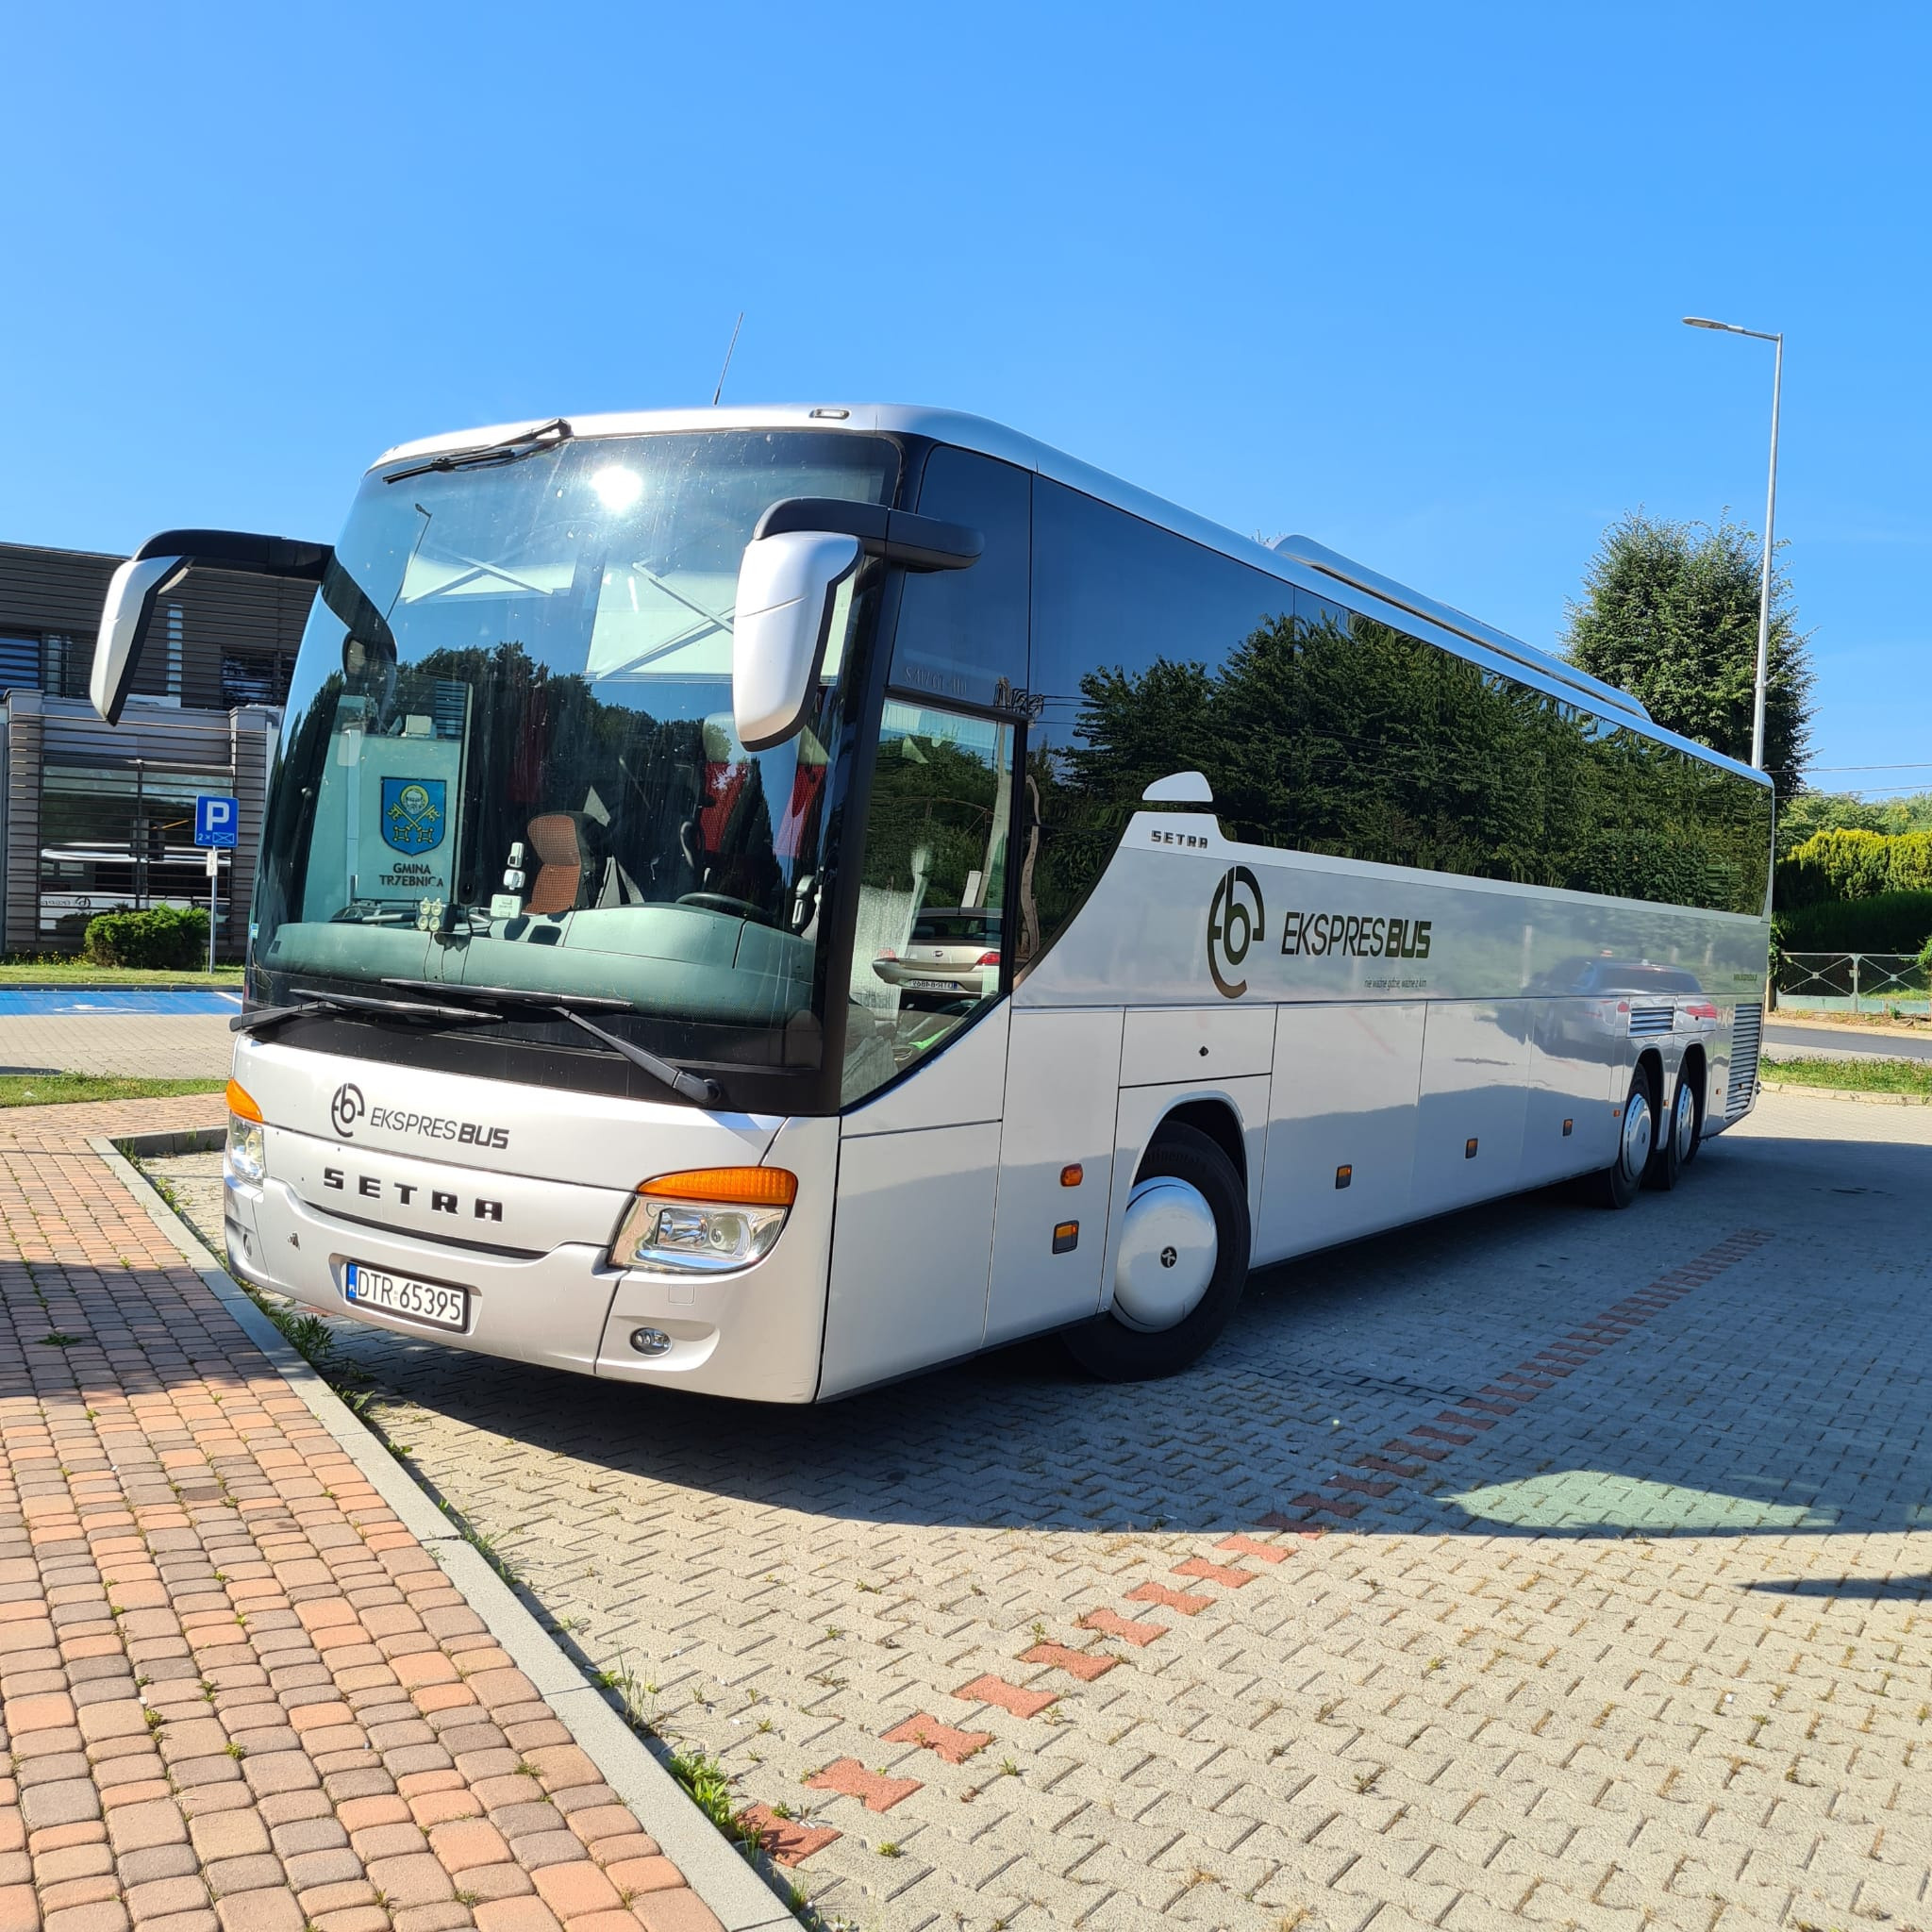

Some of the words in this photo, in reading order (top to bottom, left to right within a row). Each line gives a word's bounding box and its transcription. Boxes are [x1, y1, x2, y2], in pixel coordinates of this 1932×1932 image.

[207, 801, 230, 831] P
[1151, 830, 1208, 849] SETRA
[392, 862, 432, 874] GMINA
[1281, 911, 1432, 959] EKSPRESBUS
[370, 1107, 510, 1150] EKSPRESBUS
[324, 1167, 503, 1223] SETRA
[358, 1270, 393, 1306] DTR
[399, 1282, 462, 1322] 65395
